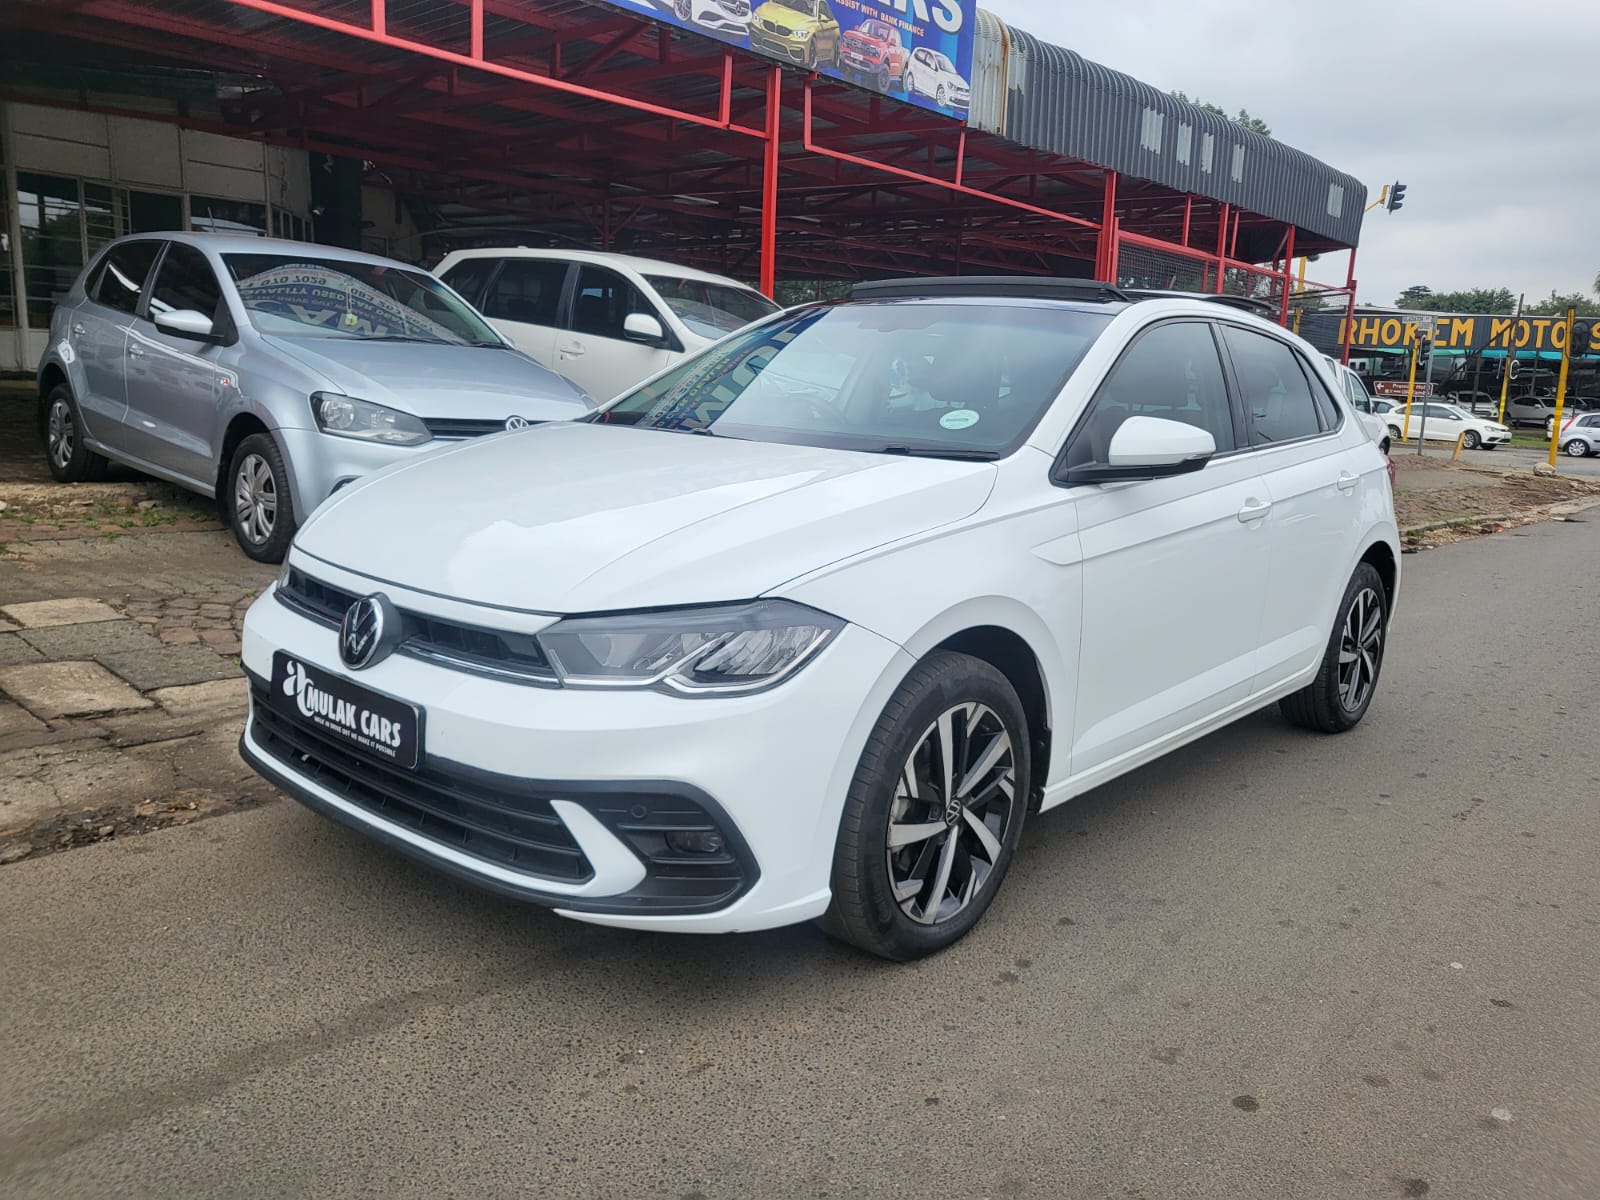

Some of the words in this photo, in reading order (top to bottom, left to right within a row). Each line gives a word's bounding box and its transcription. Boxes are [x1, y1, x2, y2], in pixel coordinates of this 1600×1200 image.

[861, 5, 878, 18] WITH
[880, 11, 898, 26] BANK
[898, 20, 924, 37] FINANCE
[1337, 317, 1475, 347] RHOKEM
[360, 709, 401, 748] CARS
